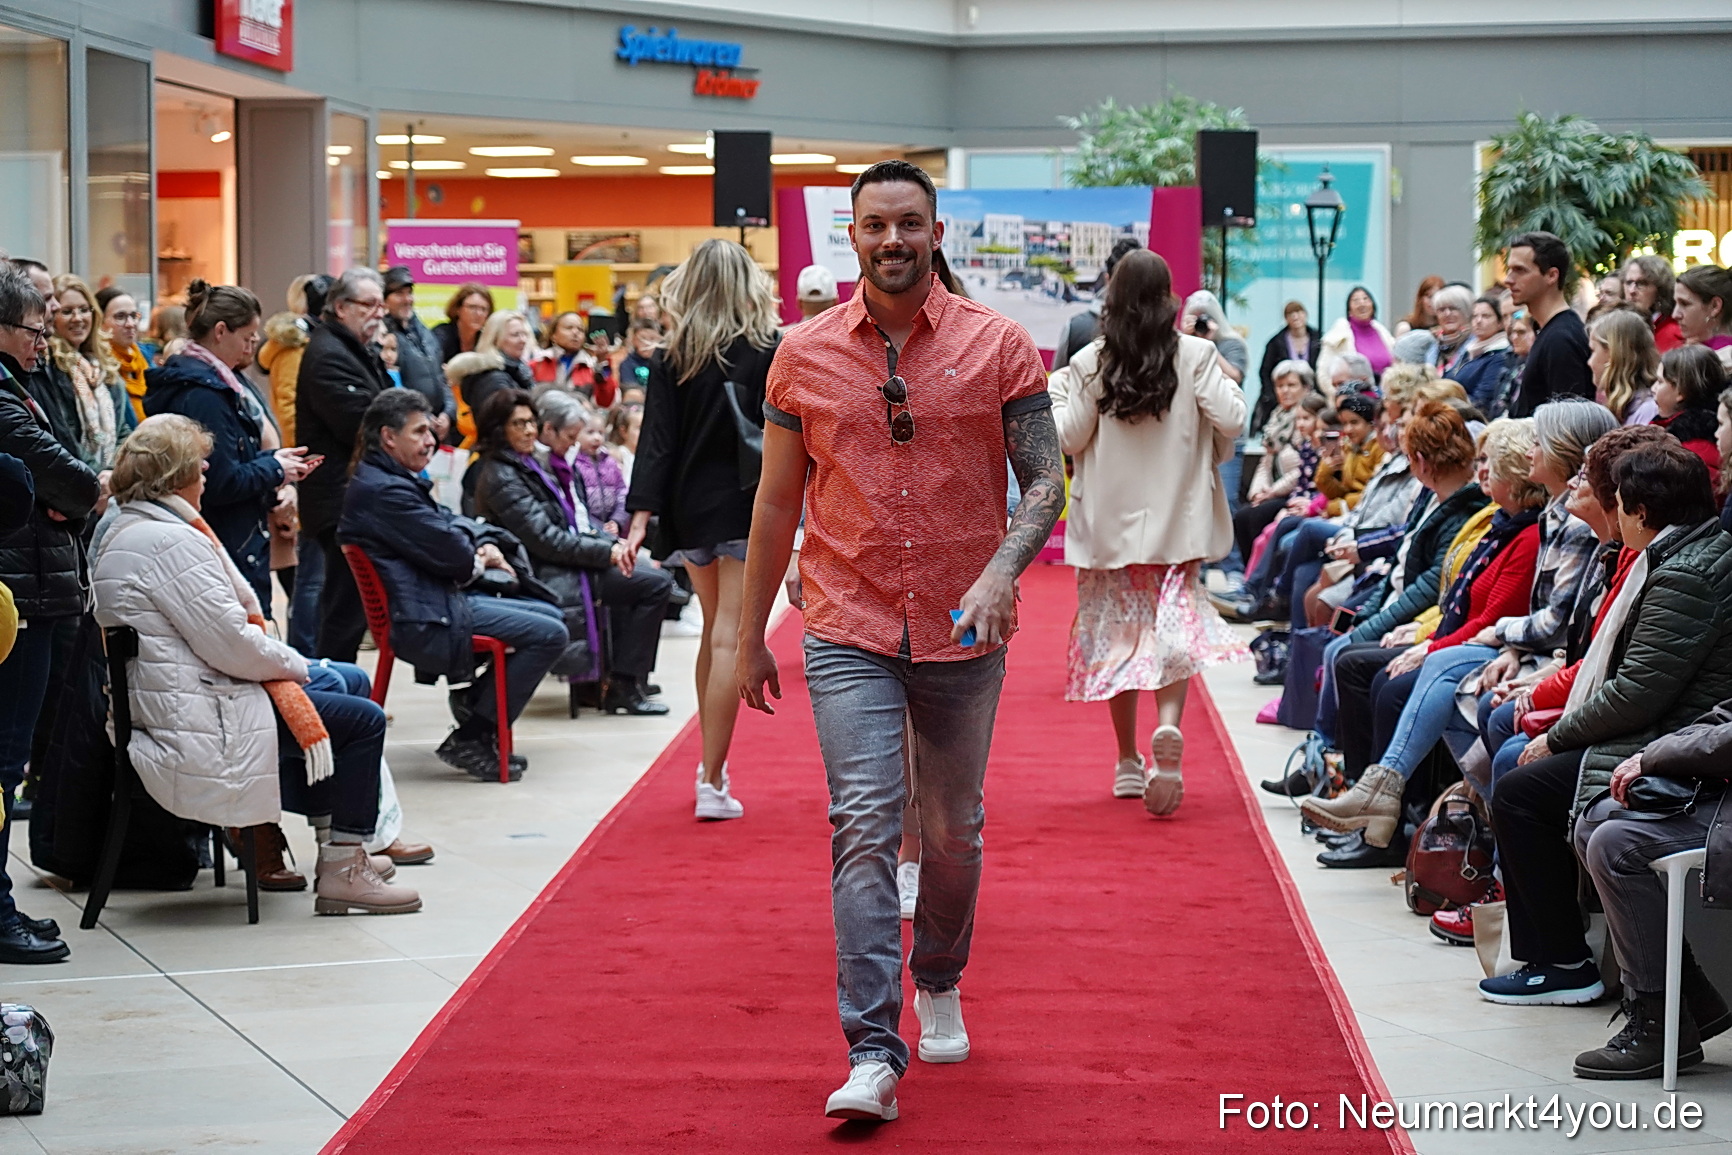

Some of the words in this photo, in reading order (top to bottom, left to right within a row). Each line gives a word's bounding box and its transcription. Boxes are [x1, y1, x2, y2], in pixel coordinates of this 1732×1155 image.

[616, 25, 743, 66] Spielwaren
[394, 243, 481, 259] Verschenken
[482, 242, 507, 259] Sie
[422, 259, 507, 276] Gutscheine!
